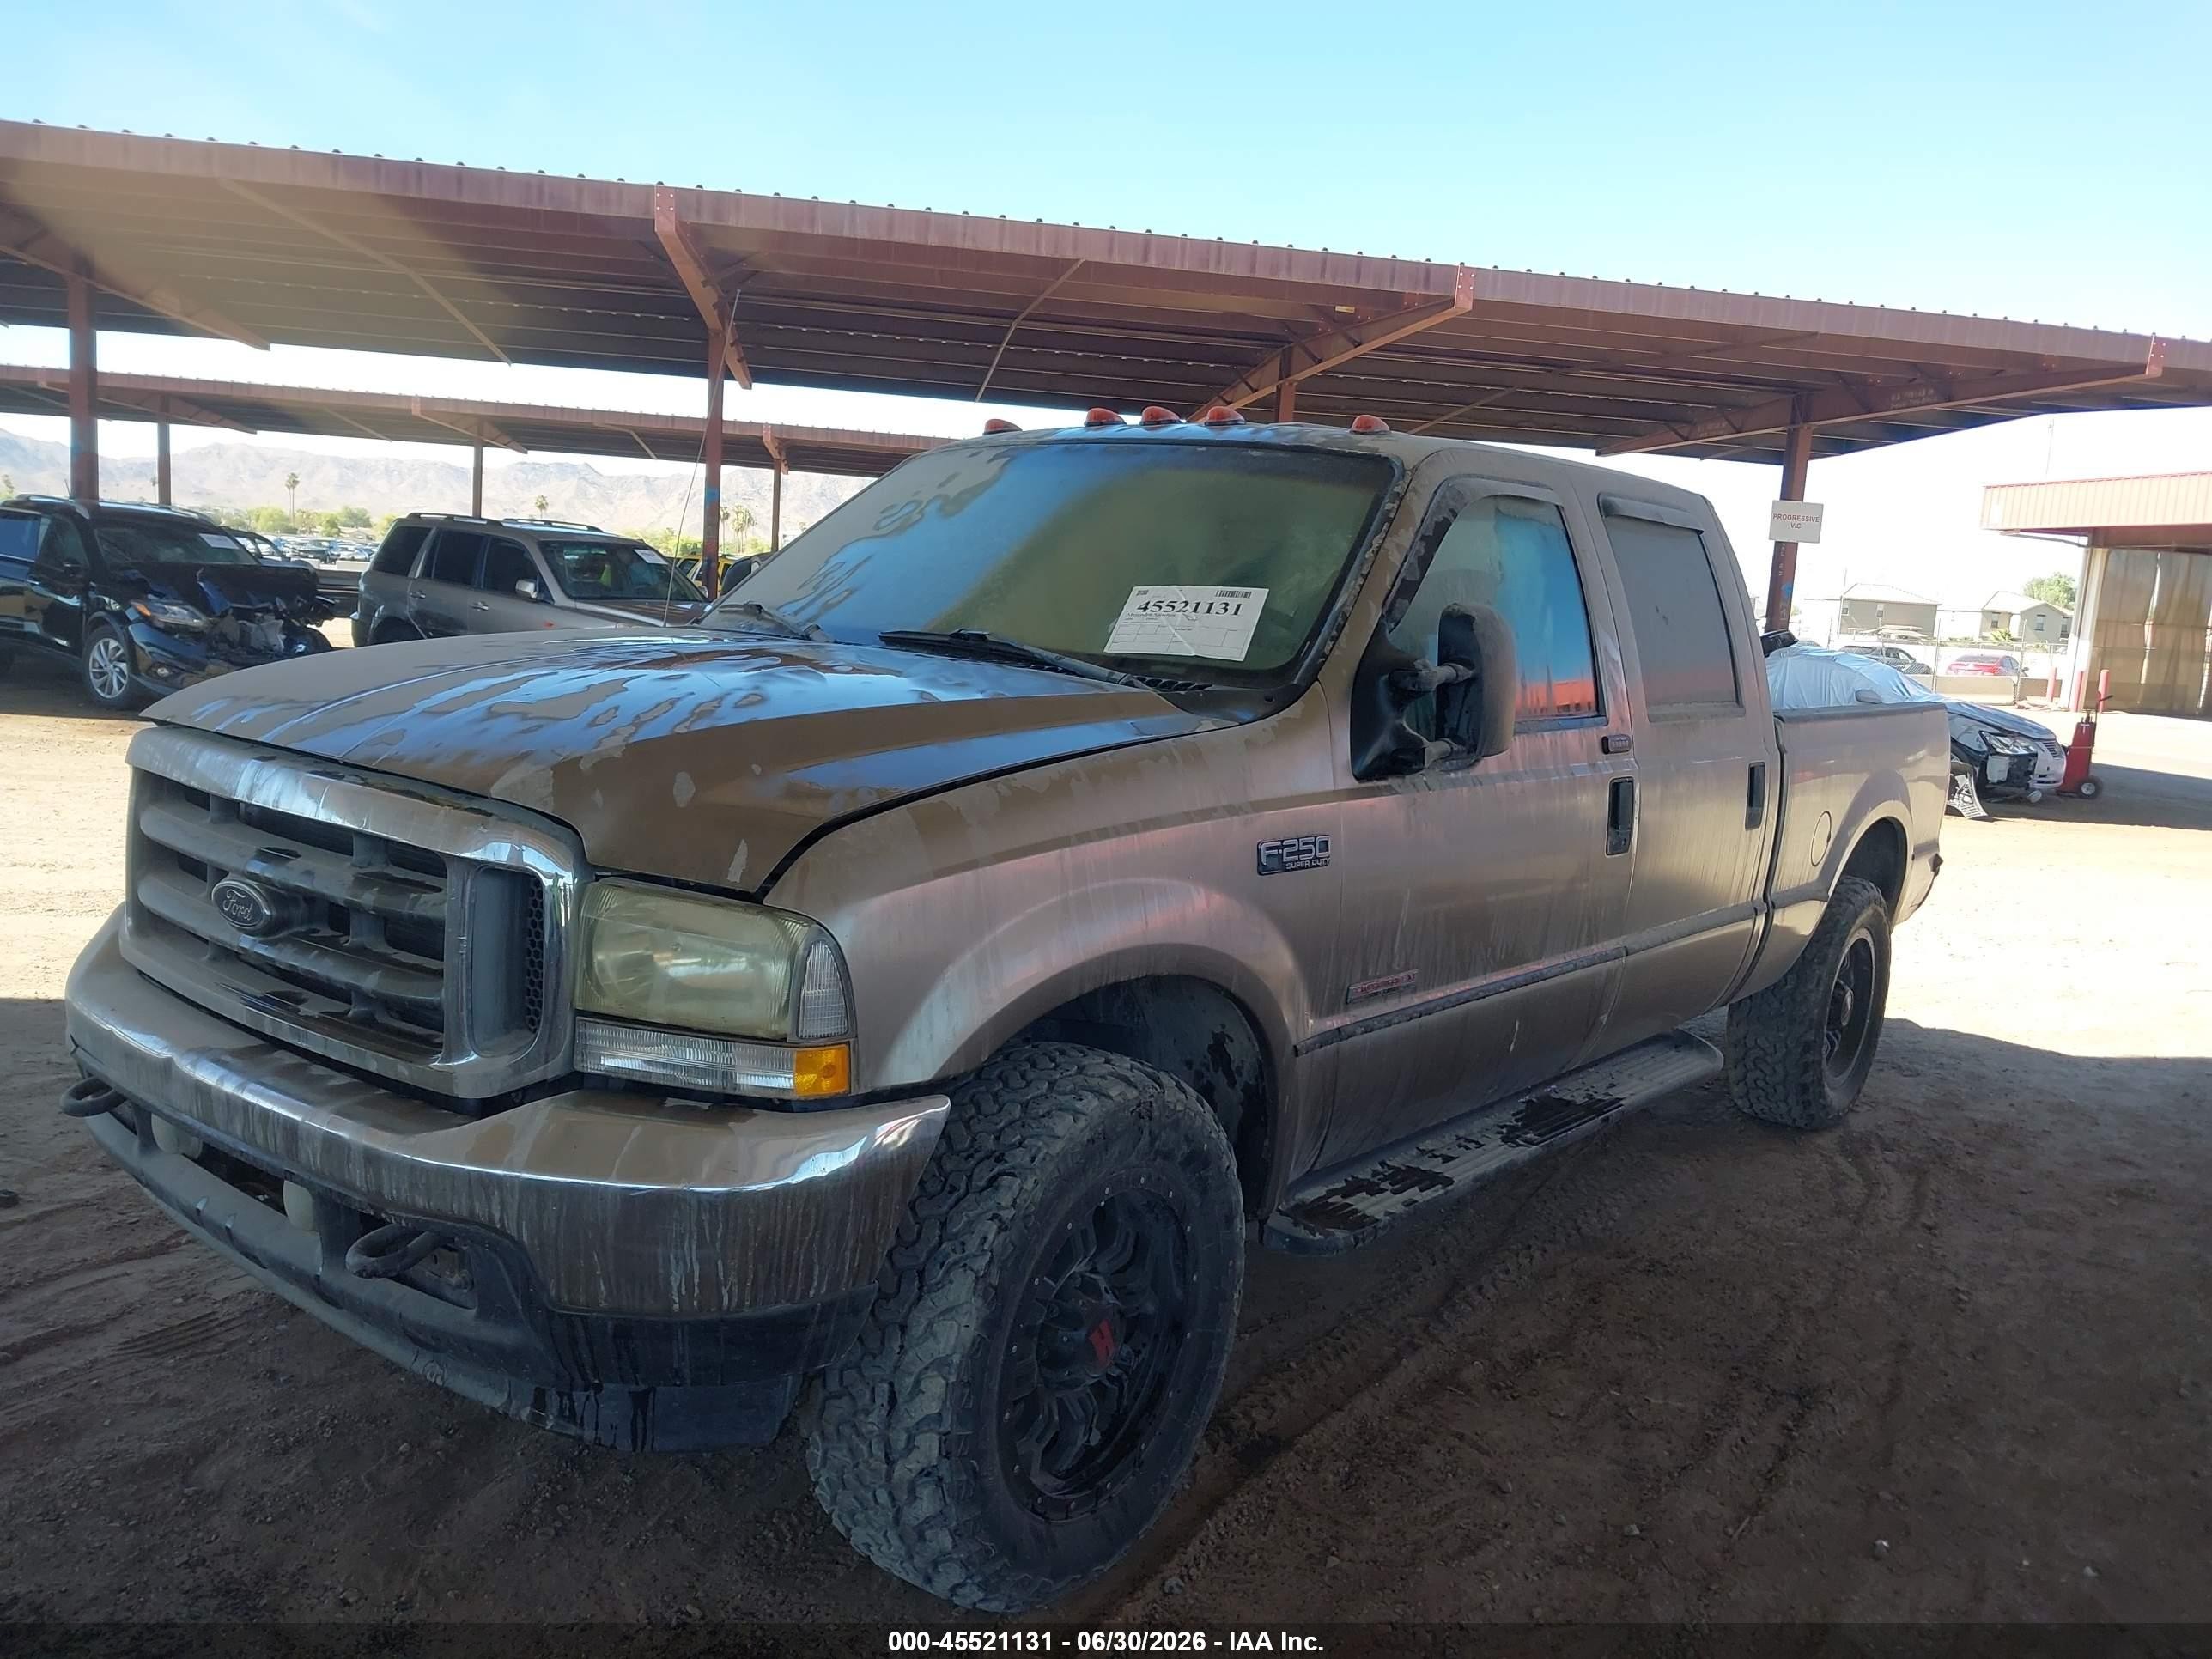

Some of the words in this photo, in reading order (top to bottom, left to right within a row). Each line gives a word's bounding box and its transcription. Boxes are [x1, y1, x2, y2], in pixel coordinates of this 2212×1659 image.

[1772, 514, 1820, 523] PROGRESSIVE
[1137, 600, 1243, 616] 45521131
[1285, 860, 1310, 870] SUPER
[1311, 858, 1331, 866] DUTY
[223, 889, 253, 921] Ford
